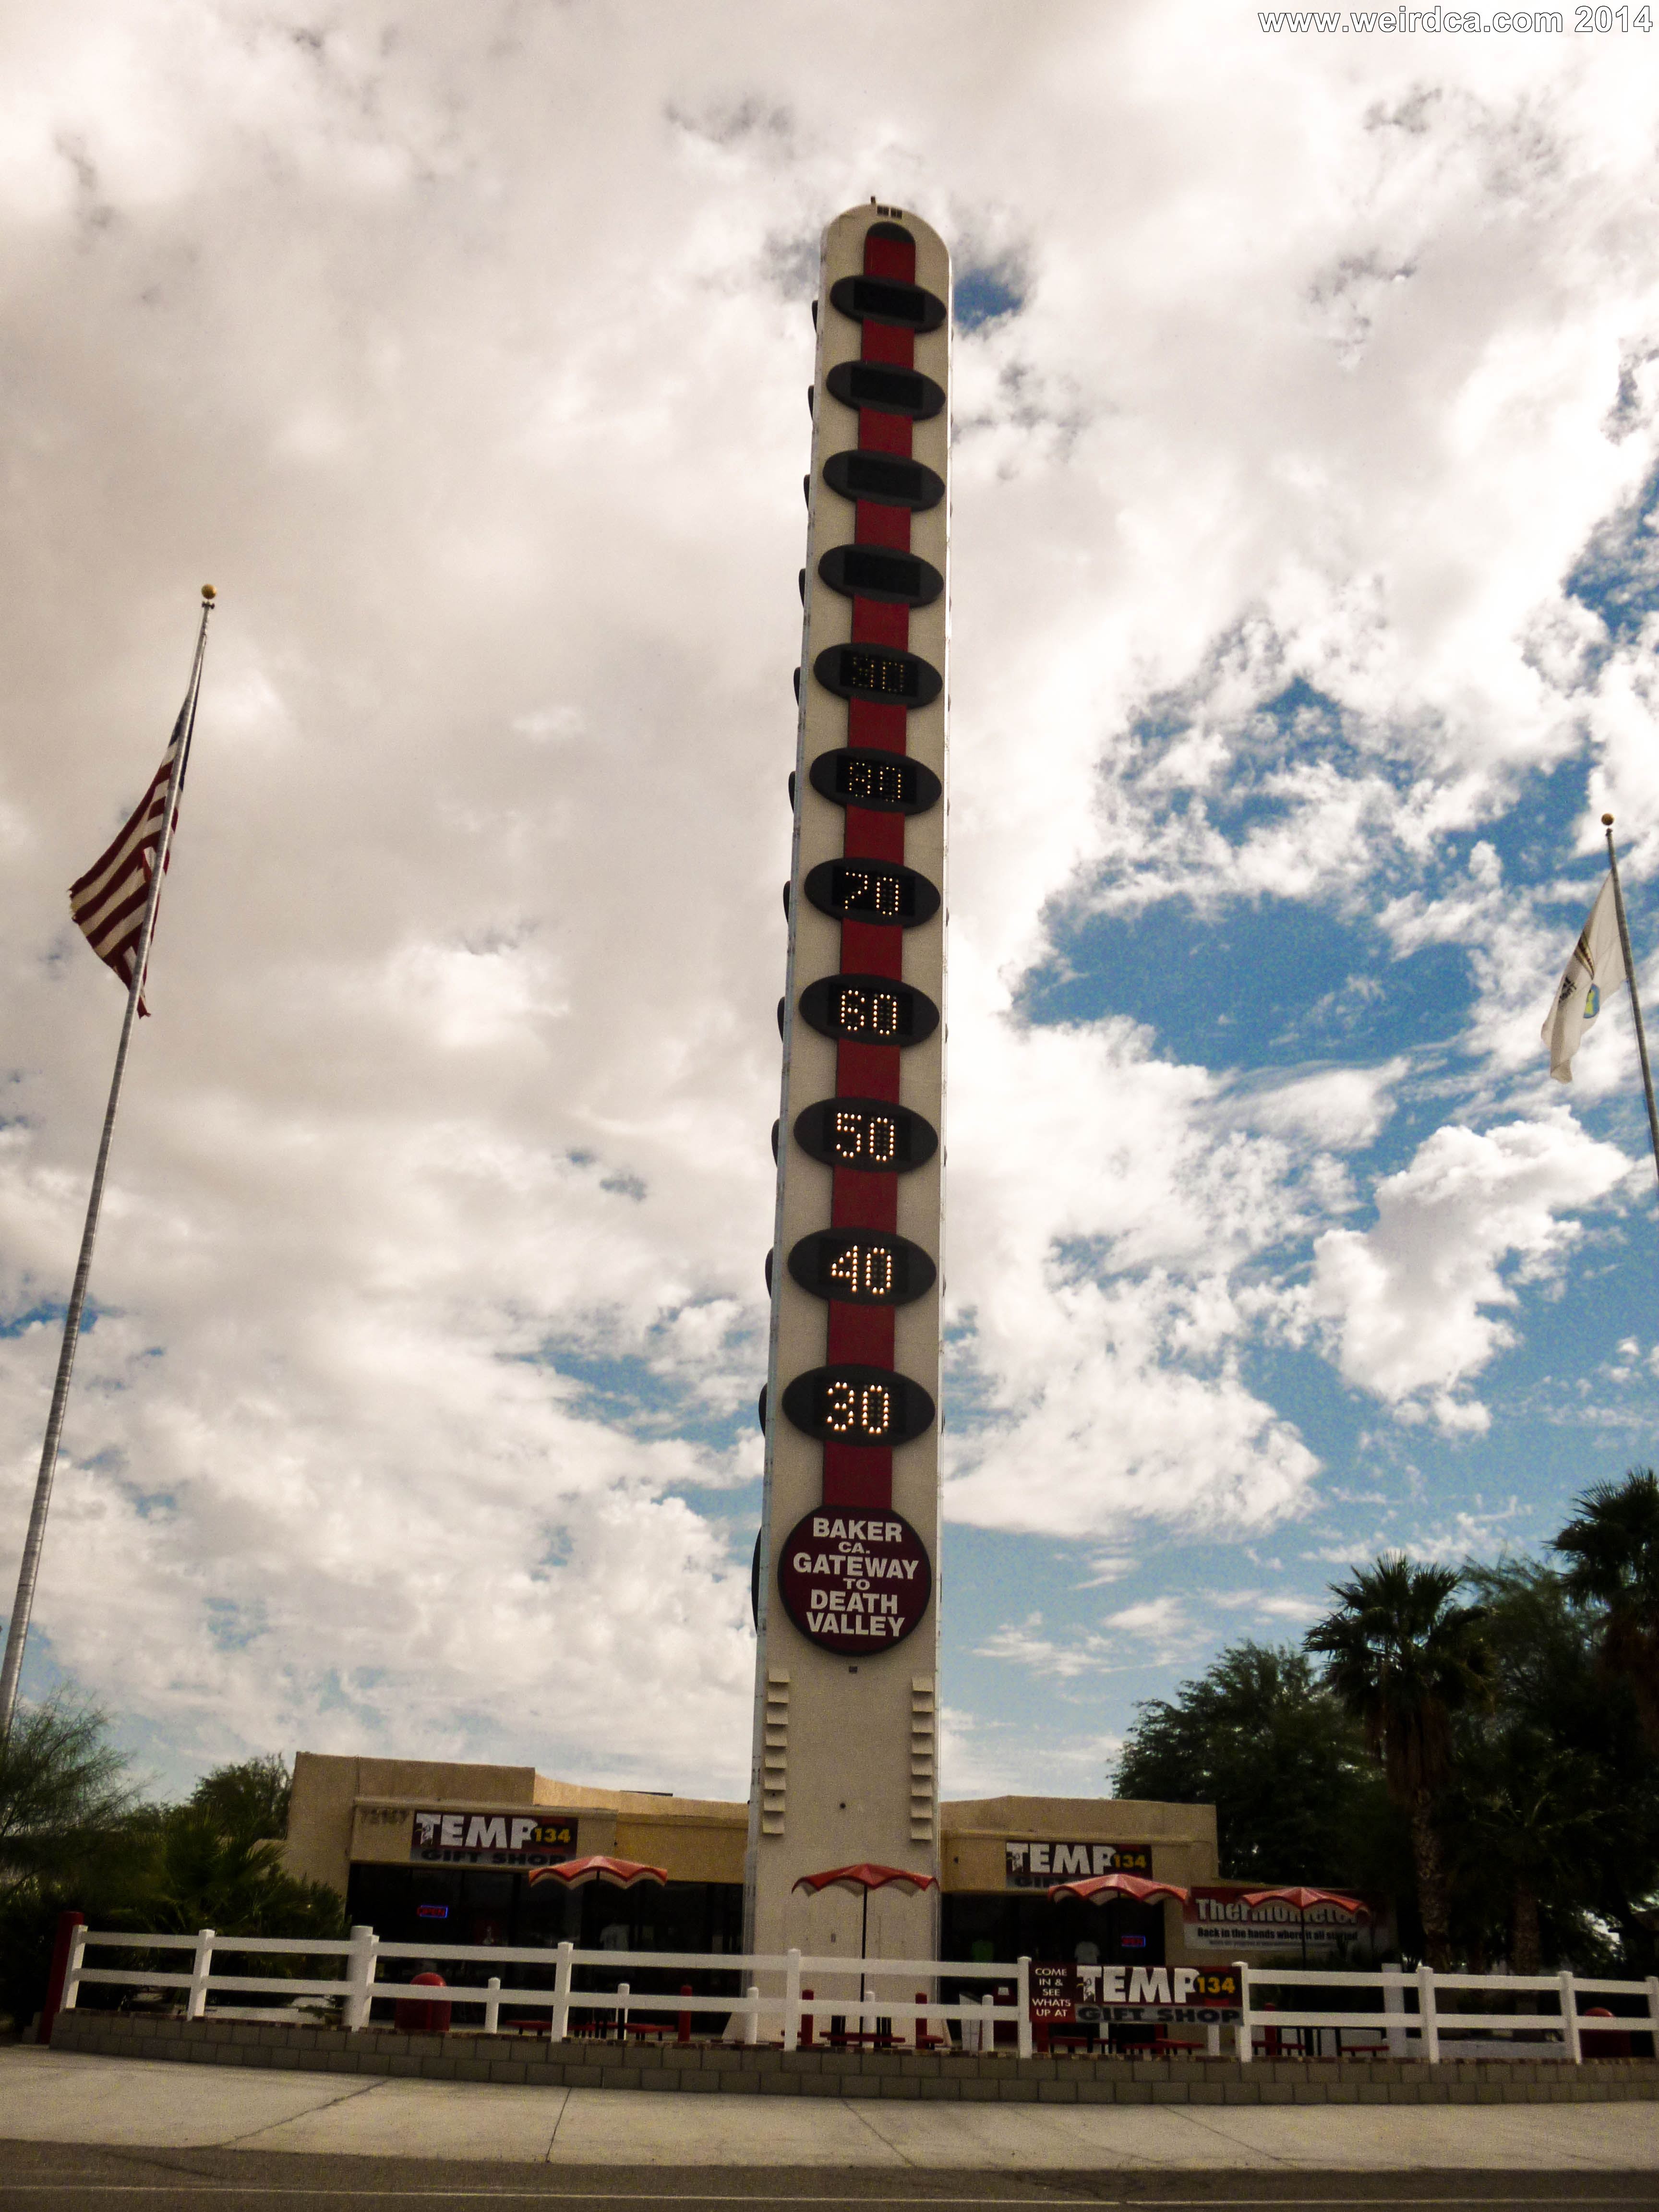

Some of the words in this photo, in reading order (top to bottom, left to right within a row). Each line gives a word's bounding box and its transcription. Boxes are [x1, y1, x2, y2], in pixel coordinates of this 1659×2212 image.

[849, 762, 903, 803] 80
[844, 871, 899, 916] 70
[841, 989, 897, 1035] 60
[836, 1112, 895, 1162] 50
[831, 1245, 892, 1295] 40
[827, 1381, 890, 1434] 30
[813, 1517, 902, 1542] BAKER
[838, 1541, 870, 1554] CA.
[793, 1552, 918, 1579] GATEWAY
[842, 1578, 870, 1590] TO
[811, 1588, 898, 1614] DEATH
[806, 1611, 905, 1637] VALLEY
[416, 1813, 538, 1850] TEMP
[534, 1827, 571, 1844] 134
[421, 1849, 481, 1863] GIFT
[493, 1852, 566, 1866] SHOP
[1006, 1842, 1116, 1875] TEMP
[1113, 1854, 1147, 1869] 134
[1198, 1926, 1220, 1937] Back
[1222, 1928, 1230, 1937] in
[1232, 1928, 1246, 1938] the
[1248, 1929, 1275, 1938] hands
[1077, 1965, 1199, 2003] TEMP
[1197, 1977, 1235, 1994] 134
[1032, 1998, 1071, 2007] WHATS
[1078, 2007, 1145, 2021] GIFT
[1157, 2008, 1240, 2022] SHOP
